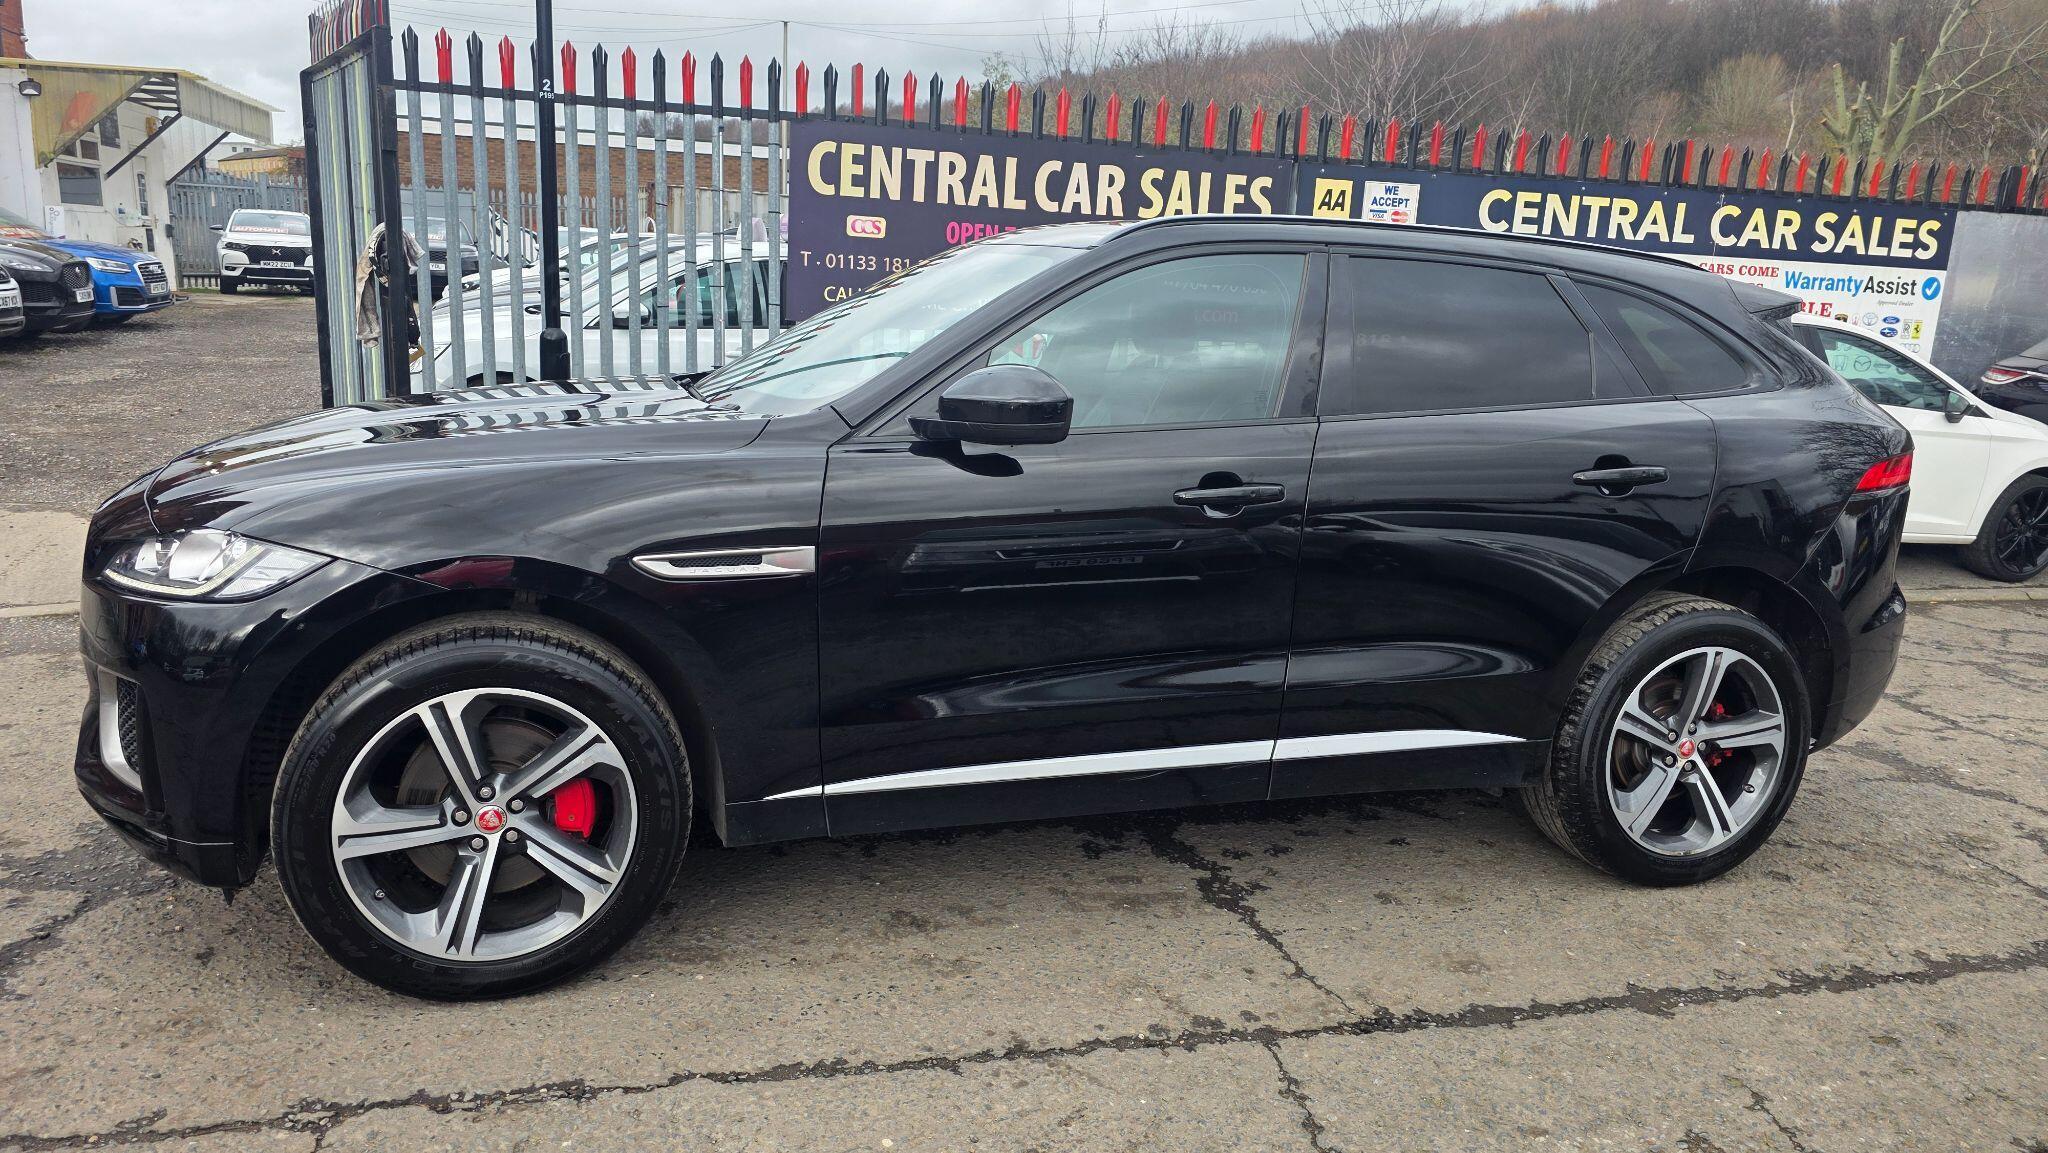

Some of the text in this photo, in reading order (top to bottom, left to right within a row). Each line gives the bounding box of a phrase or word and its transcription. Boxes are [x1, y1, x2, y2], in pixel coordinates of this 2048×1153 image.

[542, 78, 551, 91] 2
[807, 140, 1273, 217] CENTRAL CAR SALES
[1384, 185, 1399, 196] WE
[1318, 188, 1347, 211] AA
[1371, 196, 1410, 208] ACCEPT
[1478, 189, 1942, 260] CENTRAL CAR SALES
[826, 253, 877, 271] 01133
[1738, 265, 1779, 278] COME
[689, 566, 761, 574] JAGUAR
